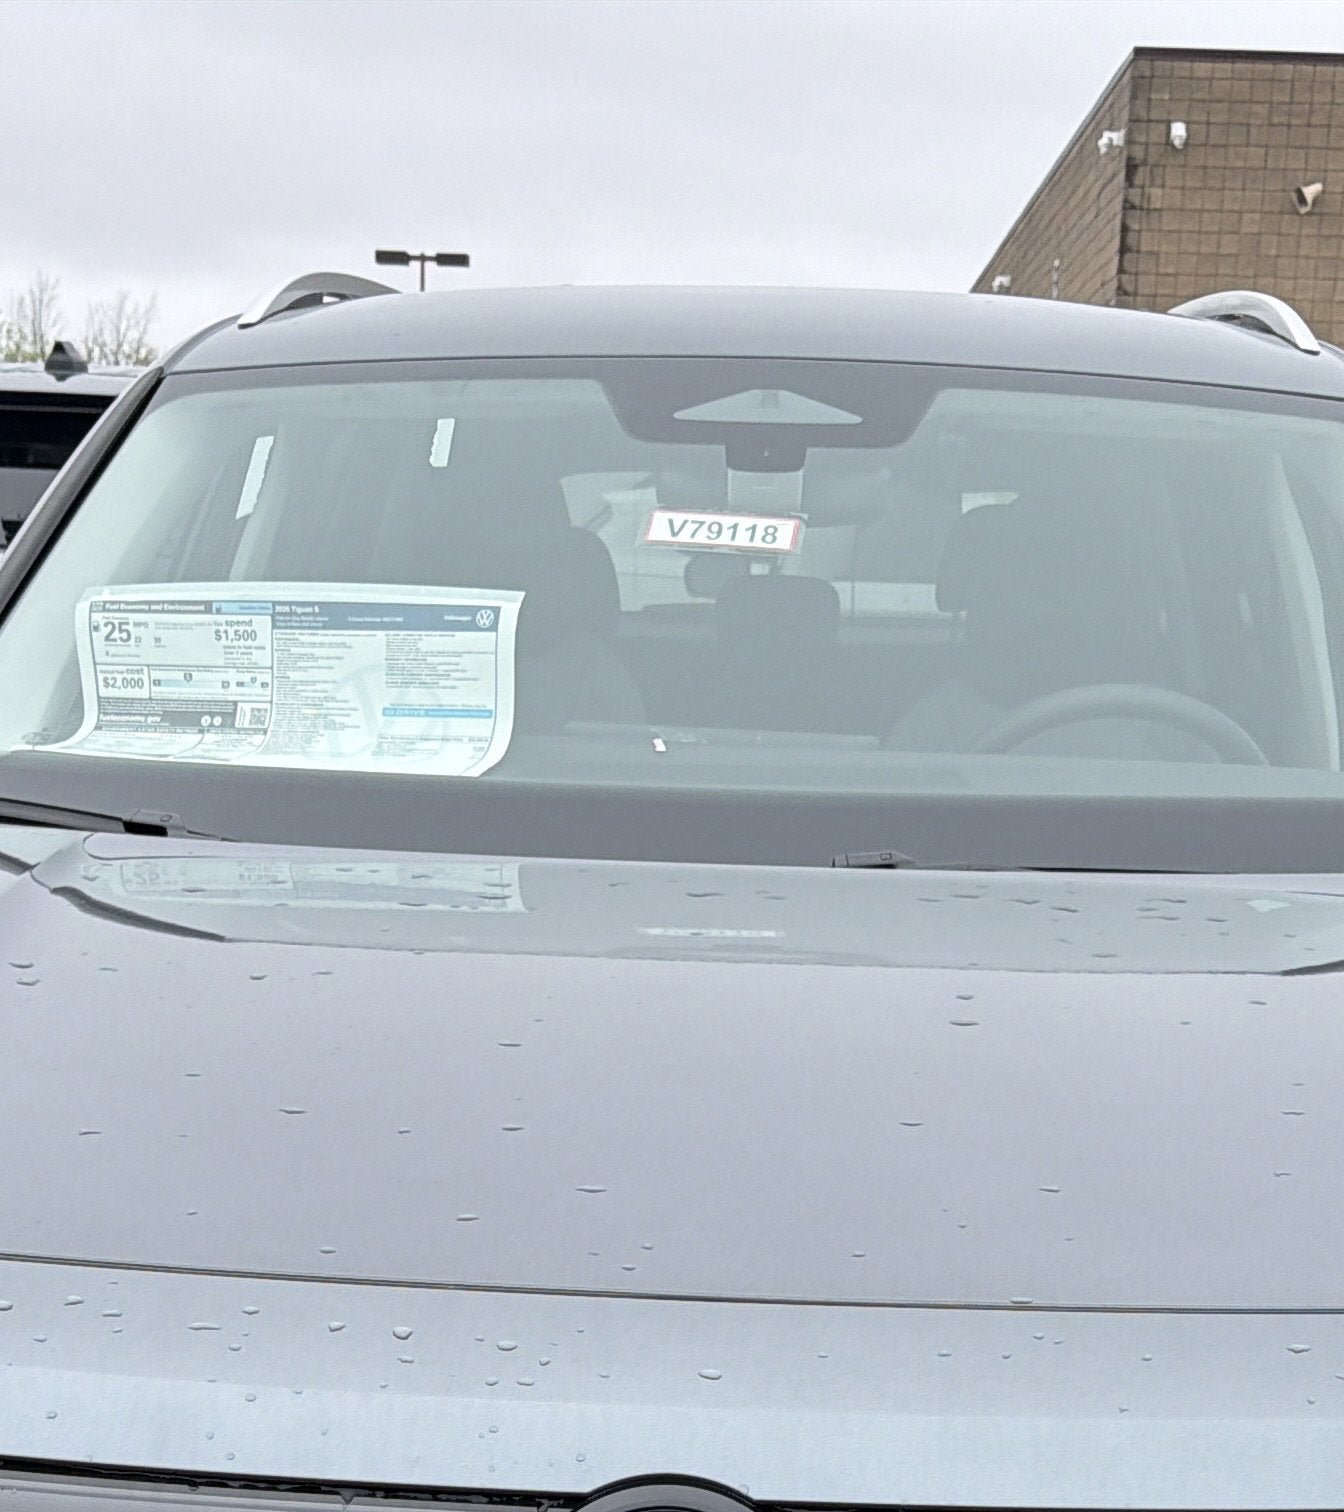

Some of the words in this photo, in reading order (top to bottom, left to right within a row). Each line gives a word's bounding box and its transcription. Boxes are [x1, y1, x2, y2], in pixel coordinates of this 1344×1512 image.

[667, 518, 779, 545] V79118
[225, 618, 253, 628] spend
[103, 621, 132, 643] 25
[214, 629, 258, 643] $1,500
[125, 667, 144, 675] cost
[102, 676, 145, 690] $2,000
